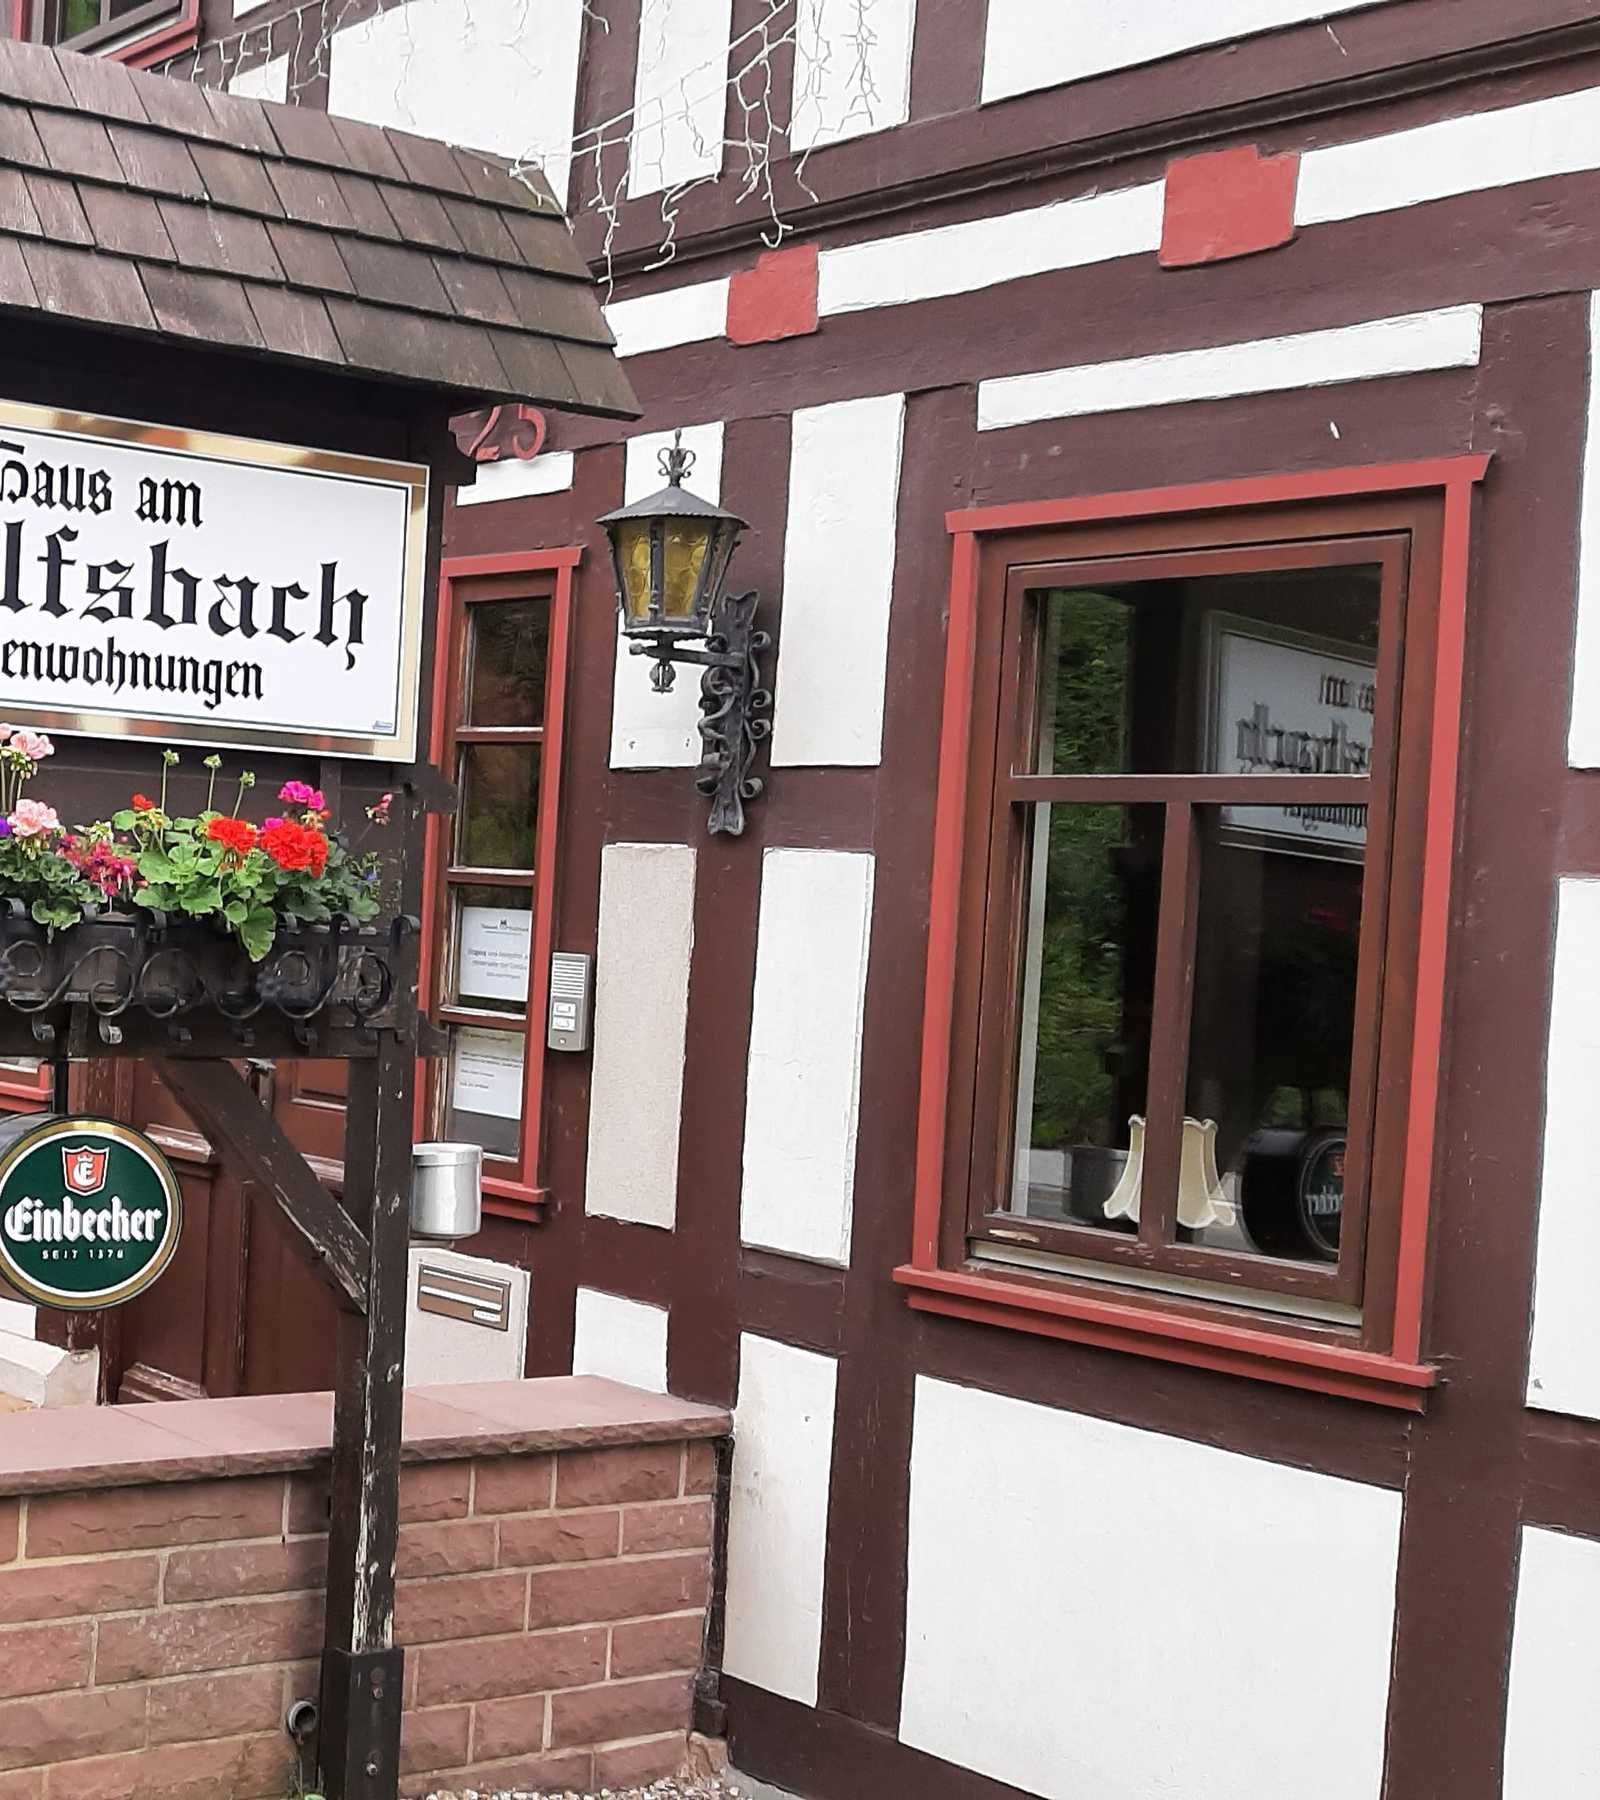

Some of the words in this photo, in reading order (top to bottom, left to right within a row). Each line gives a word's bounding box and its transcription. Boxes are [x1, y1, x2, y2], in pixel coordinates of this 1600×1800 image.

[135, 476, 203, 528] am
[4, 1196, 163, 1242] Einbecher
[42, 1249, 78, 1260] SEIT
